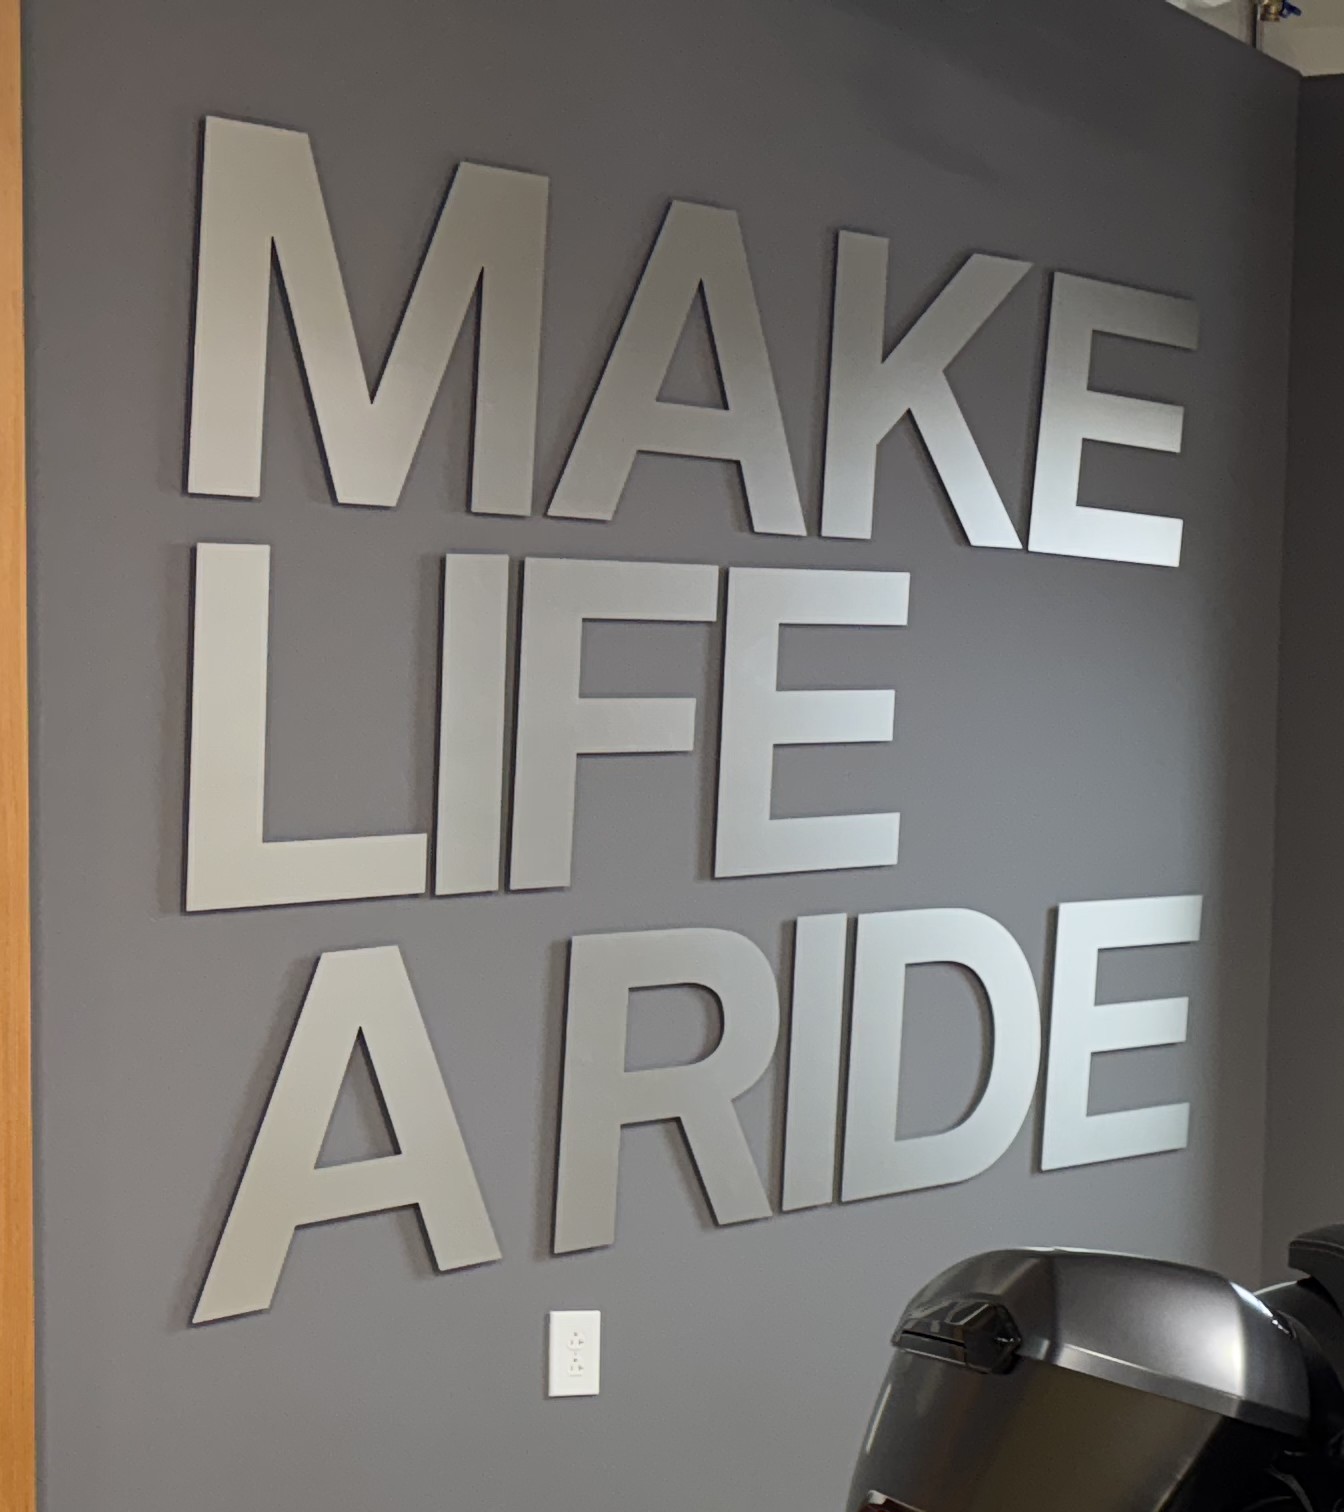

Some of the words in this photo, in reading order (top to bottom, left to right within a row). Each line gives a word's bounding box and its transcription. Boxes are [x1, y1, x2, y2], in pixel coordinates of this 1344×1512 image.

[187, 115, 1197, 568] MAKE
[185, 541, 912, 913] LIFE
[192, 945, 503, 1325] A
[553, 894, 1203, 1254] RIDE
